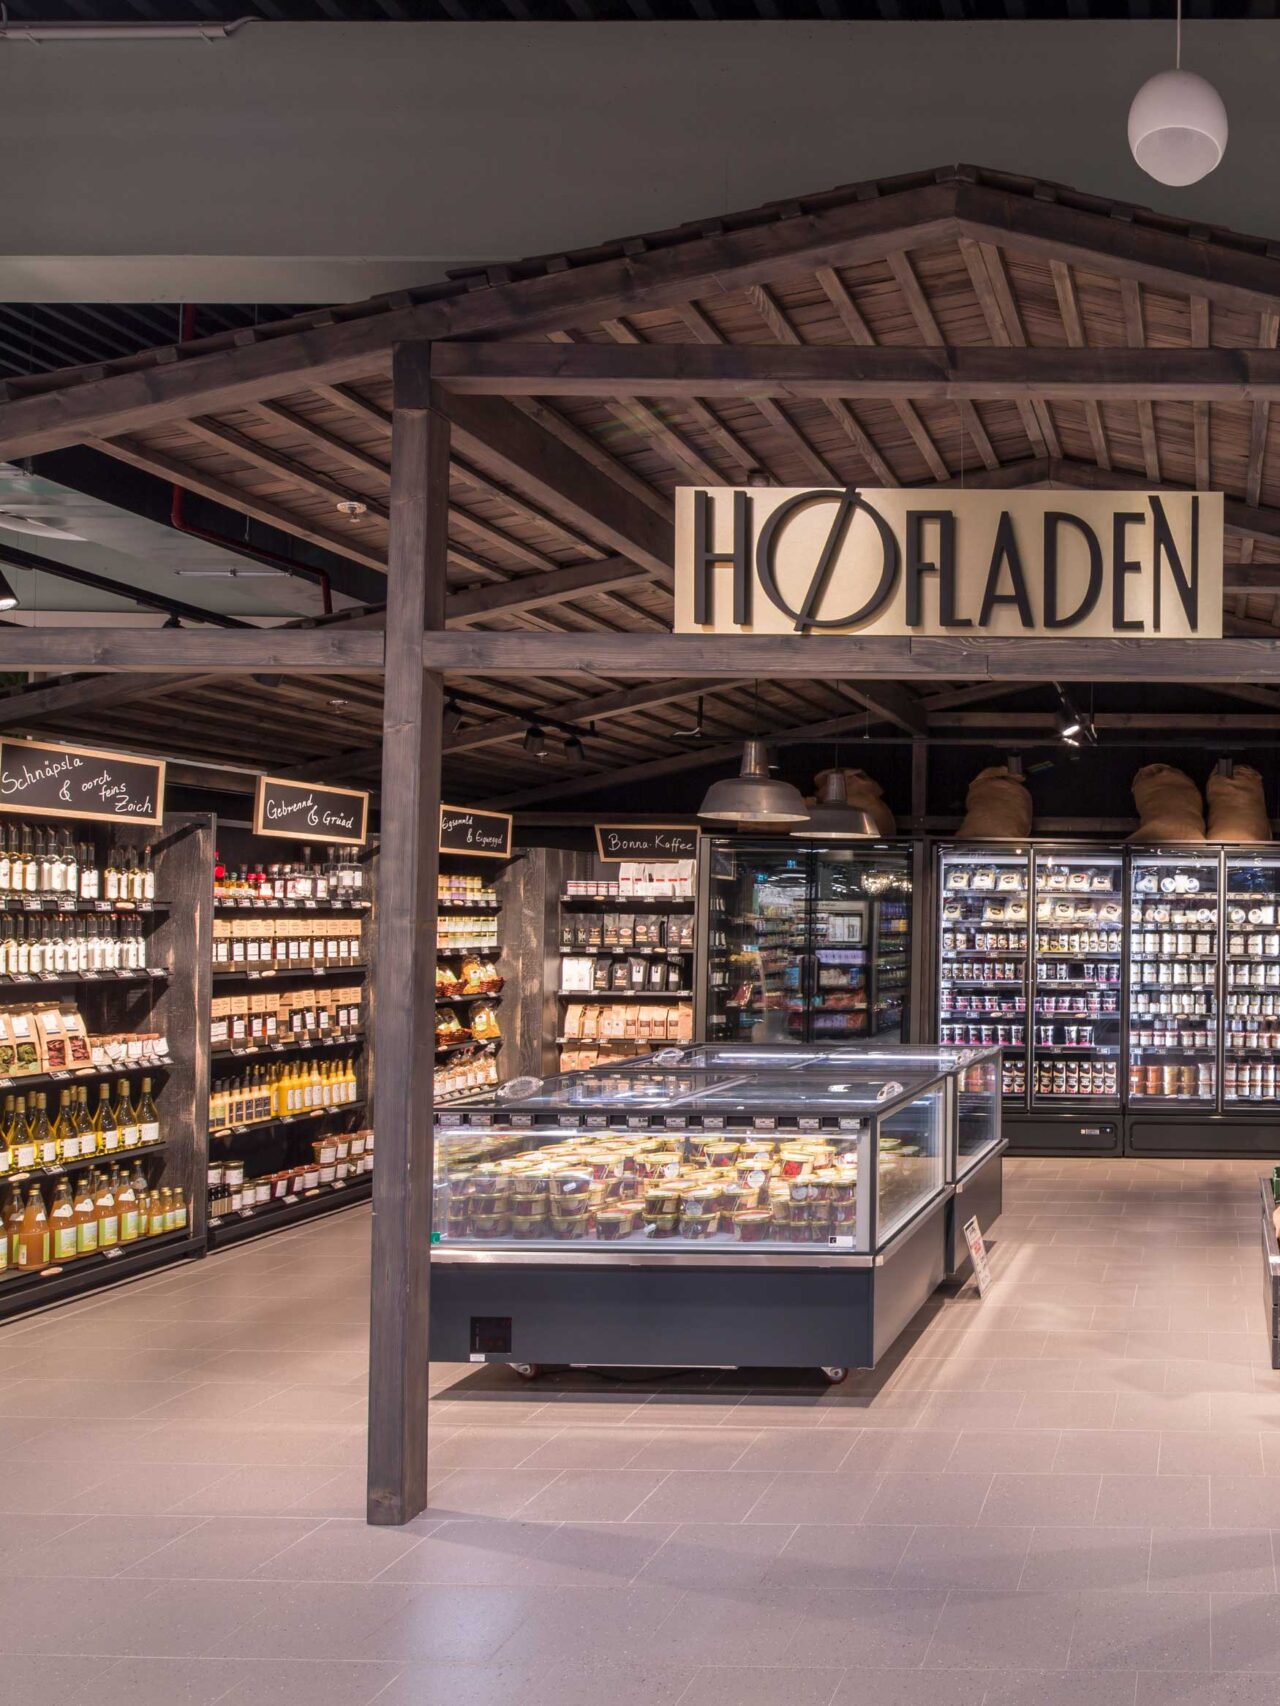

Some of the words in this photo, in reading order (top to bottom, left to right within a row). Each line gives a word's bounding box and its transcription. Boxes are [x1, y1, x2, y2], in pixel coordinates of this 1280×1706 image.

[1, 754, 84, 794] Schnäpsla
[59, 779, 72, 802] &
[82, 770, 112, 791] oorch
[99, 783, 126, 801] feins
[307, 805, 319, 826] &
